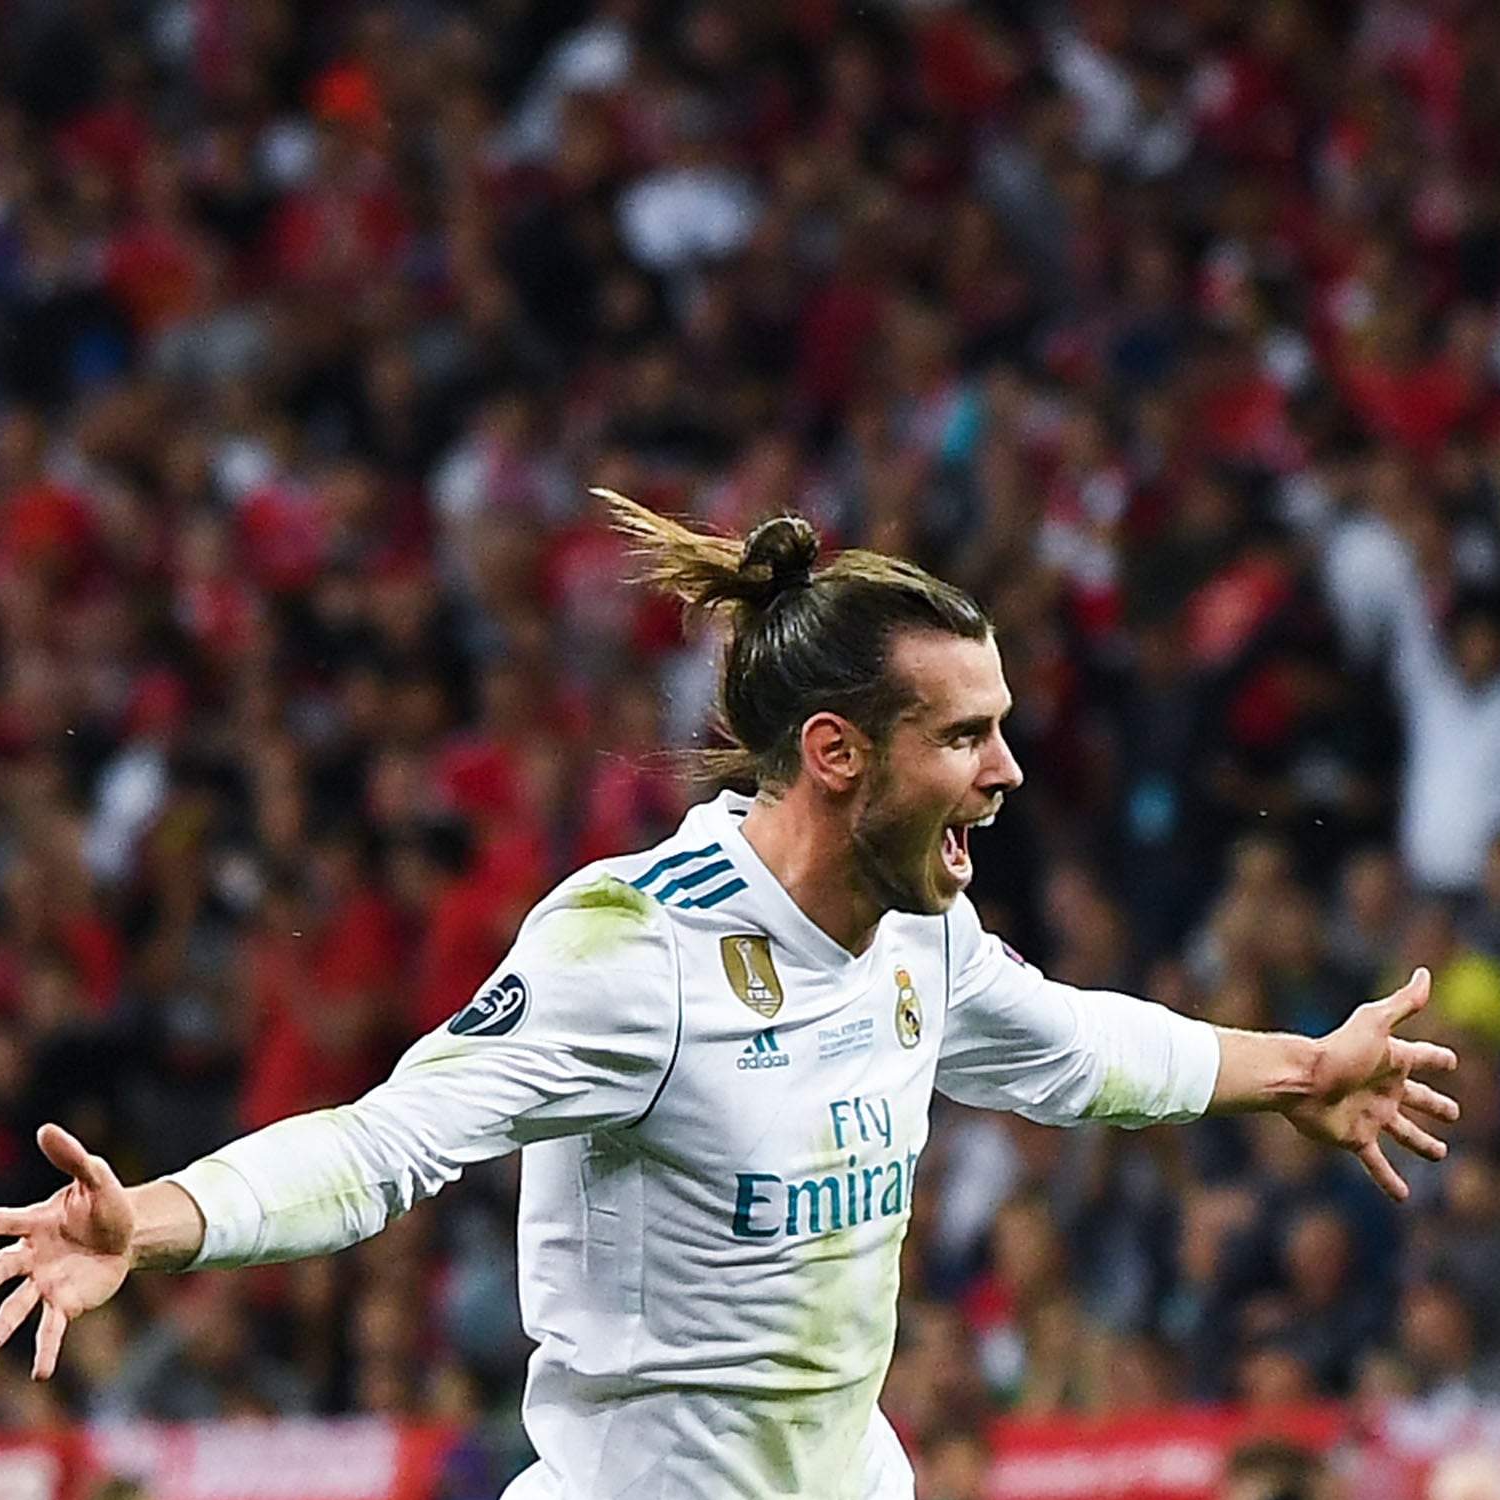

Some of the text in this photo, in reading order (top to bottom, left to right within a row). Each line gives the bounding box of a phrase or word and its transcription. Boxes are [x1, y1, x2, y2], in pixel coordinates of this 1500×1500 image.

[736, 1053, 790, 1071] adidas
[829, 1096, 893, 1150] Fly
[731, 1145, 917, 1238] Emirat
